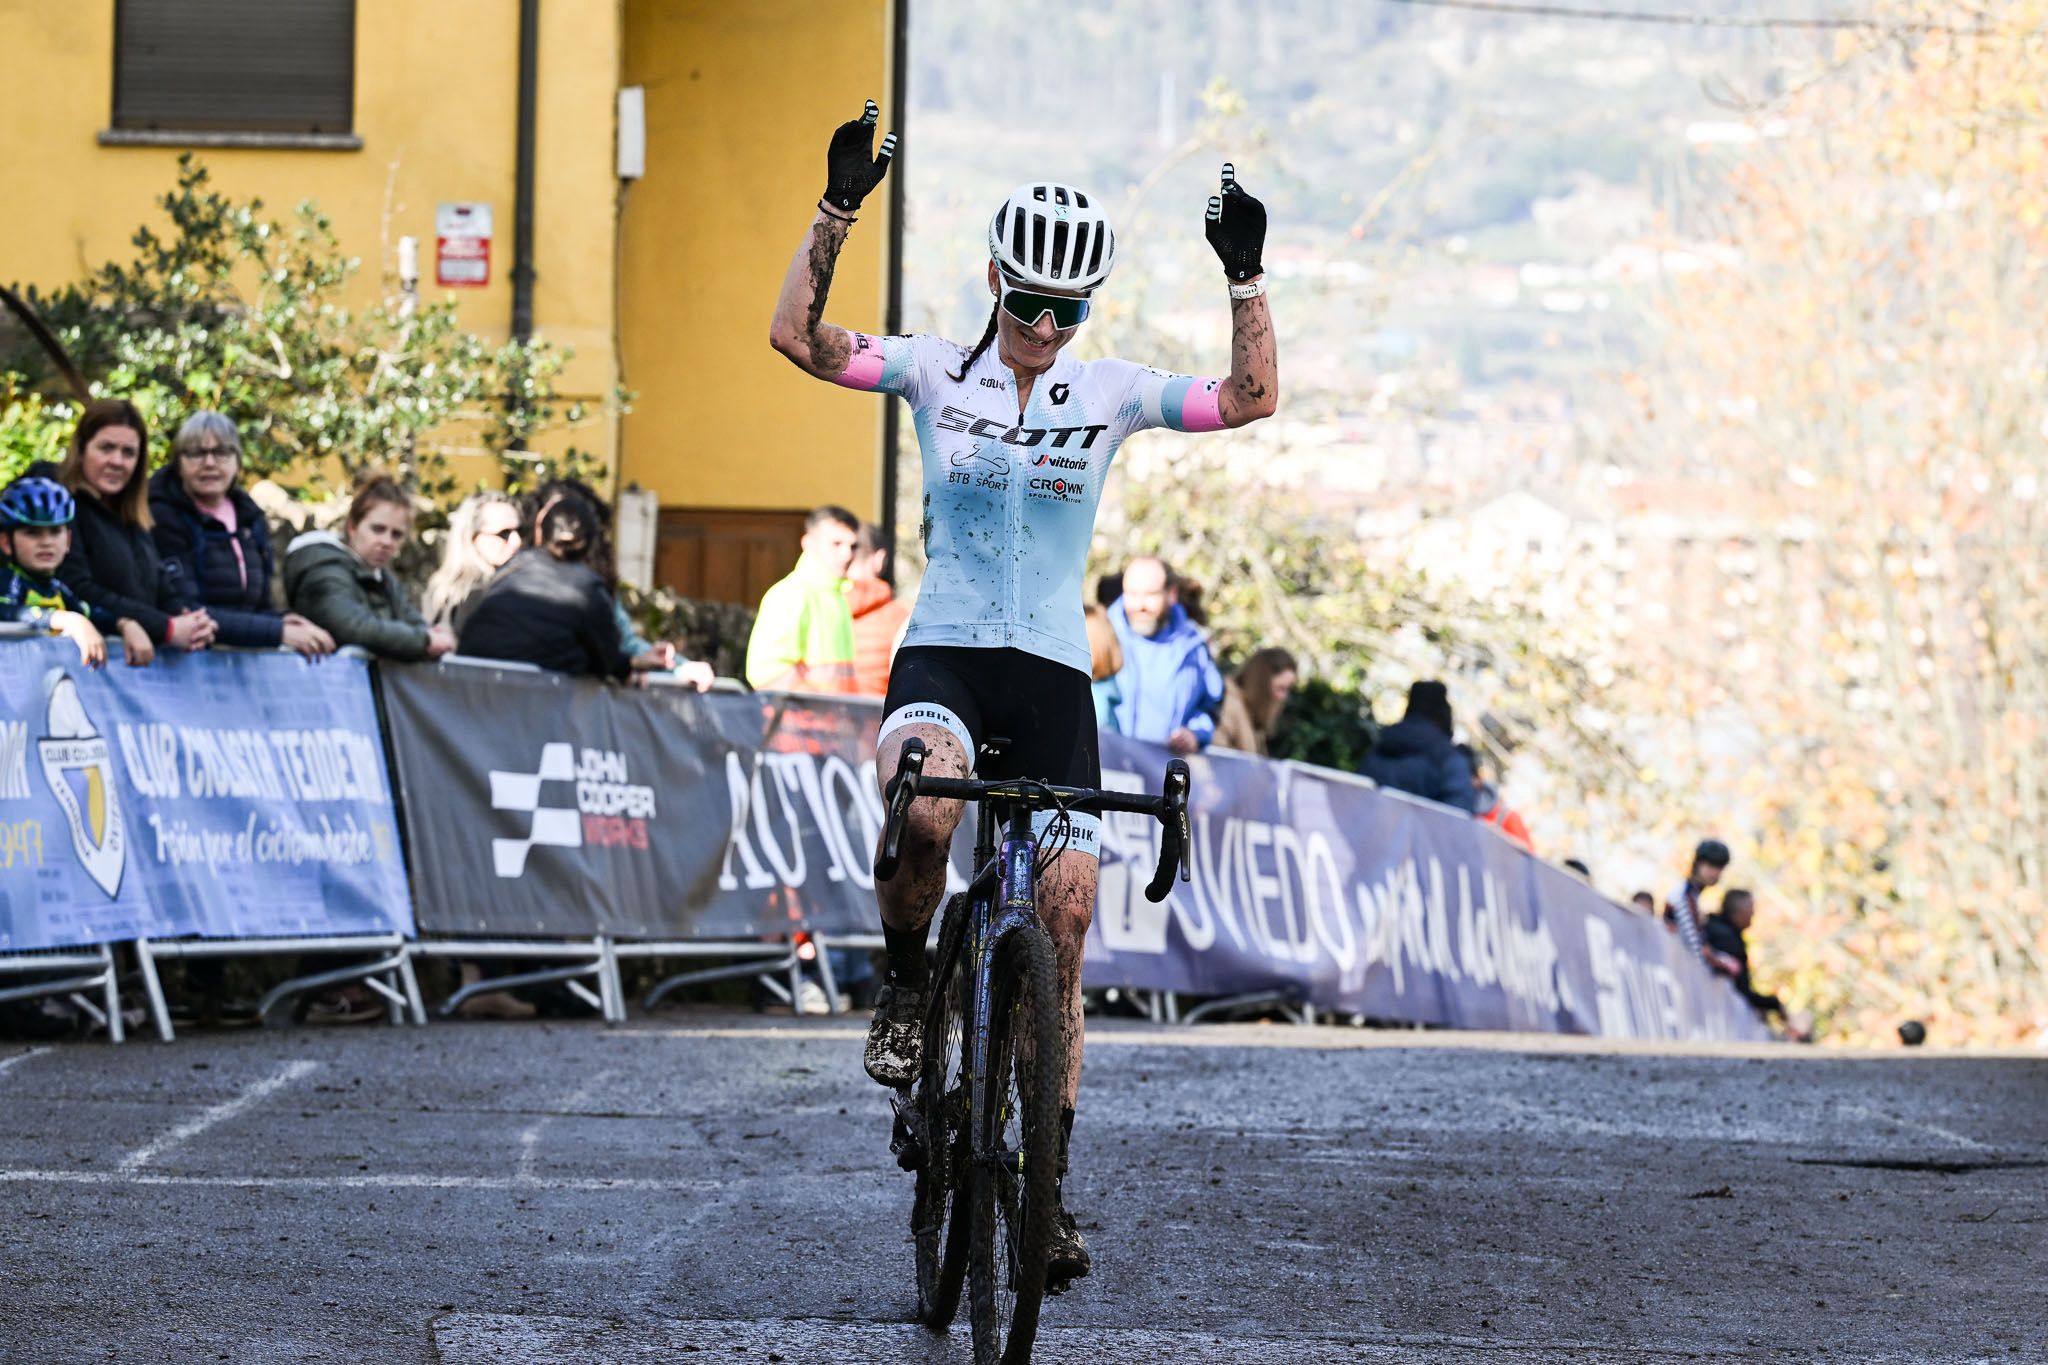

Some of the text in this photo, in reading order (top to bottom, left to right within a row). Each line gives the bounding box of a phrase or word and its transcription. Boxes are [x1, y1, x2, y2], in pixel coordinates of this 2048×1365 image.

[936, 405, 1108, 449] SCOTT
[1049, 456, 1086, 470] vittoria
[949, 471, 1008, 491] BTB SPORT
[1030, 477, 1083, 495] CROWN
[1028, 492, 1051, 500] SPORT
[904, 710, 950, 725] GOBIK
[576, 748, 628, 784] JOHN
[576, 781, 656, 819] COOPER
[1050, 824, 1093, 842] GOBIK
[1155, 812, 1357, 972] OVIEDO
